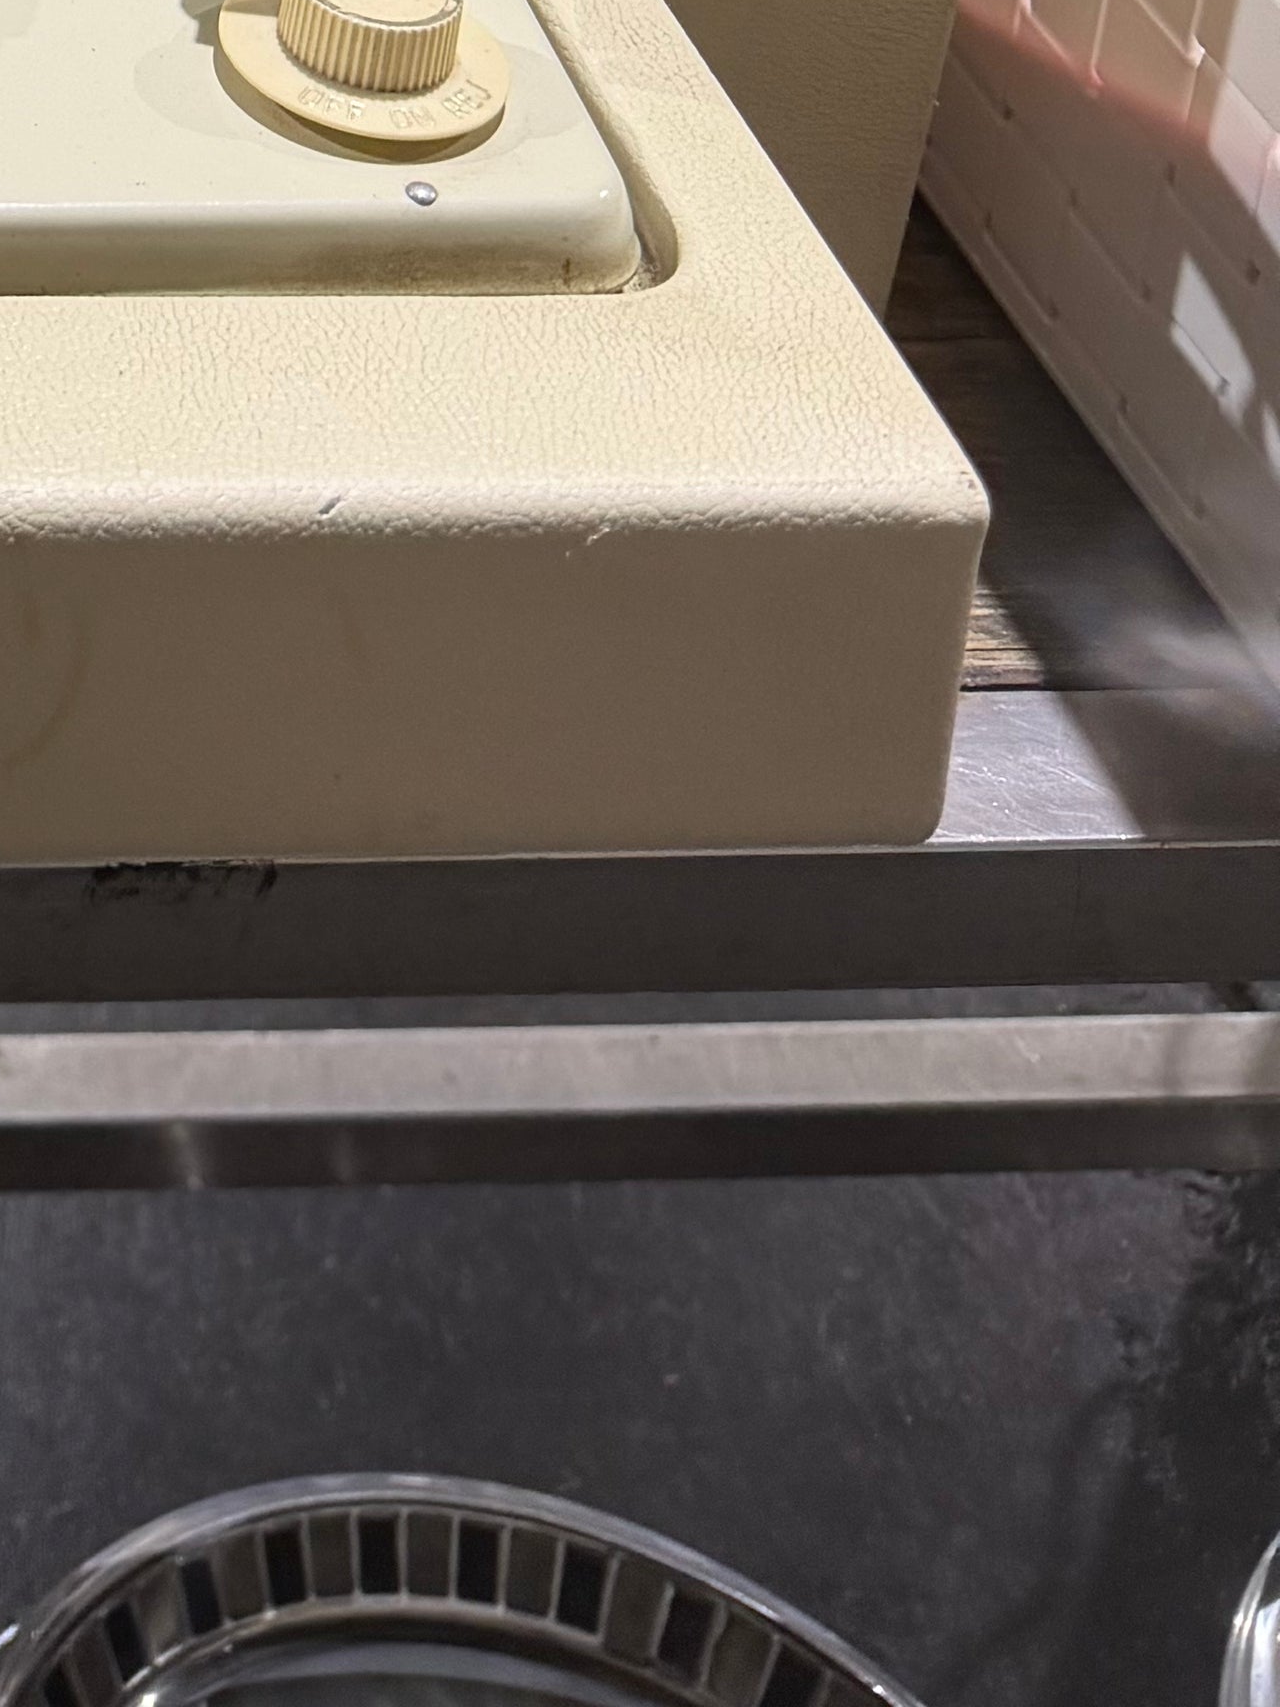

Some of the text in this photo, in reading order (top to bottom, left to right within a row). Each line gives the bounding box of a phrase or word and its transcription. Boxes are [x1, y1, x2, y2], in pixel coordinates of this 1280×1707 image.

[298, 86, 366, 121] OFF
[441, 79, 492, 119] REJ
[390, 105, 437, 130] ON
